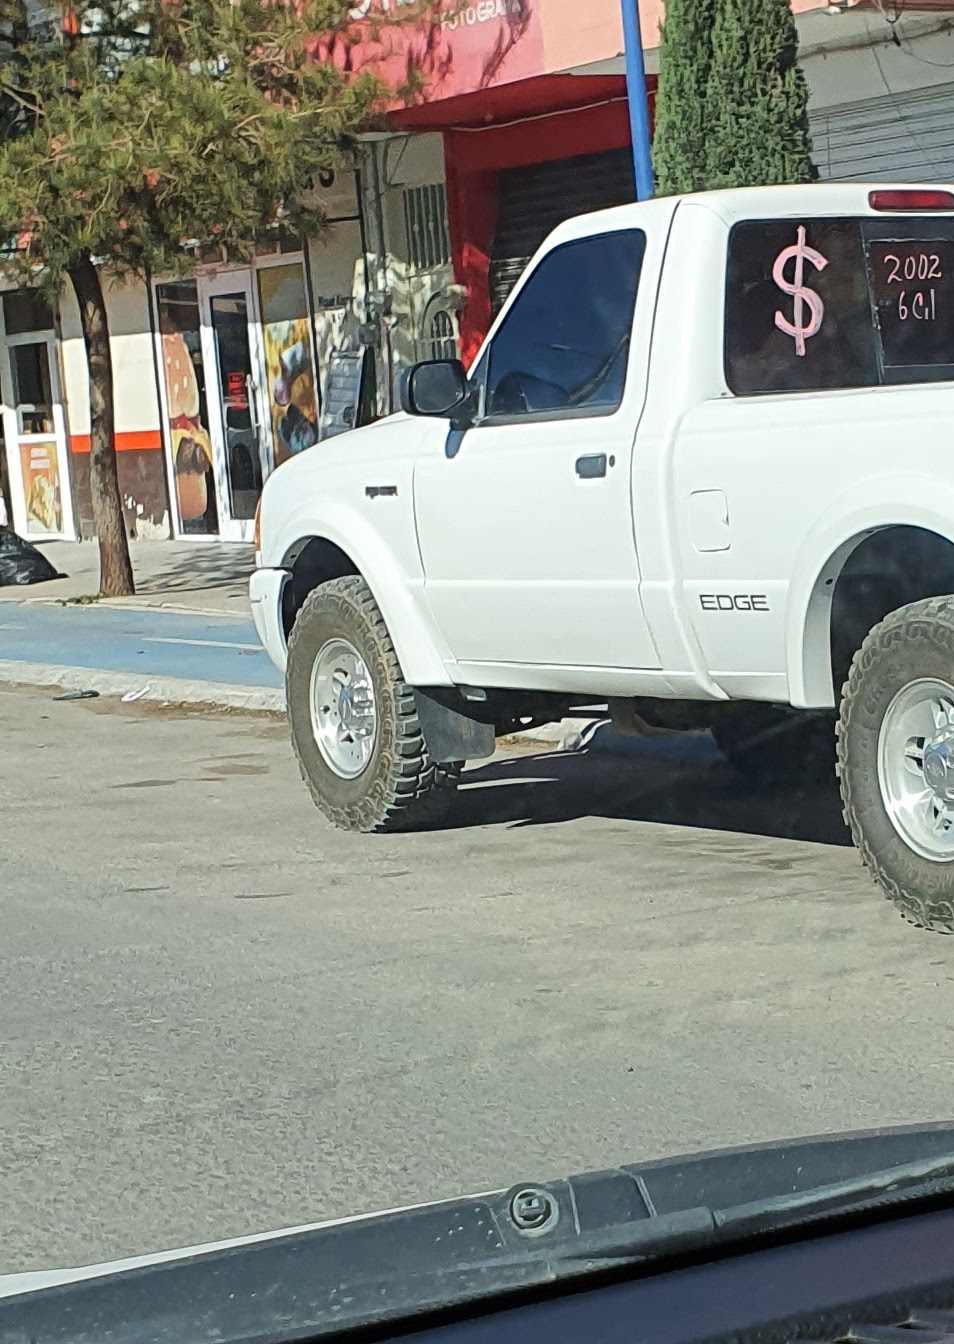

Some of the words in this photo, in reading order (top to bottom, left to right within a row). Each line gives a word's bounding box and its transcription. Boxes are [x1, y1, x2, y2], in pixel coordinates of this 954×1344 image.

[883, 253, 942, 283] 2002
[772, 225, 828, 356] $
[699, 593, 770, 612] EDGE
